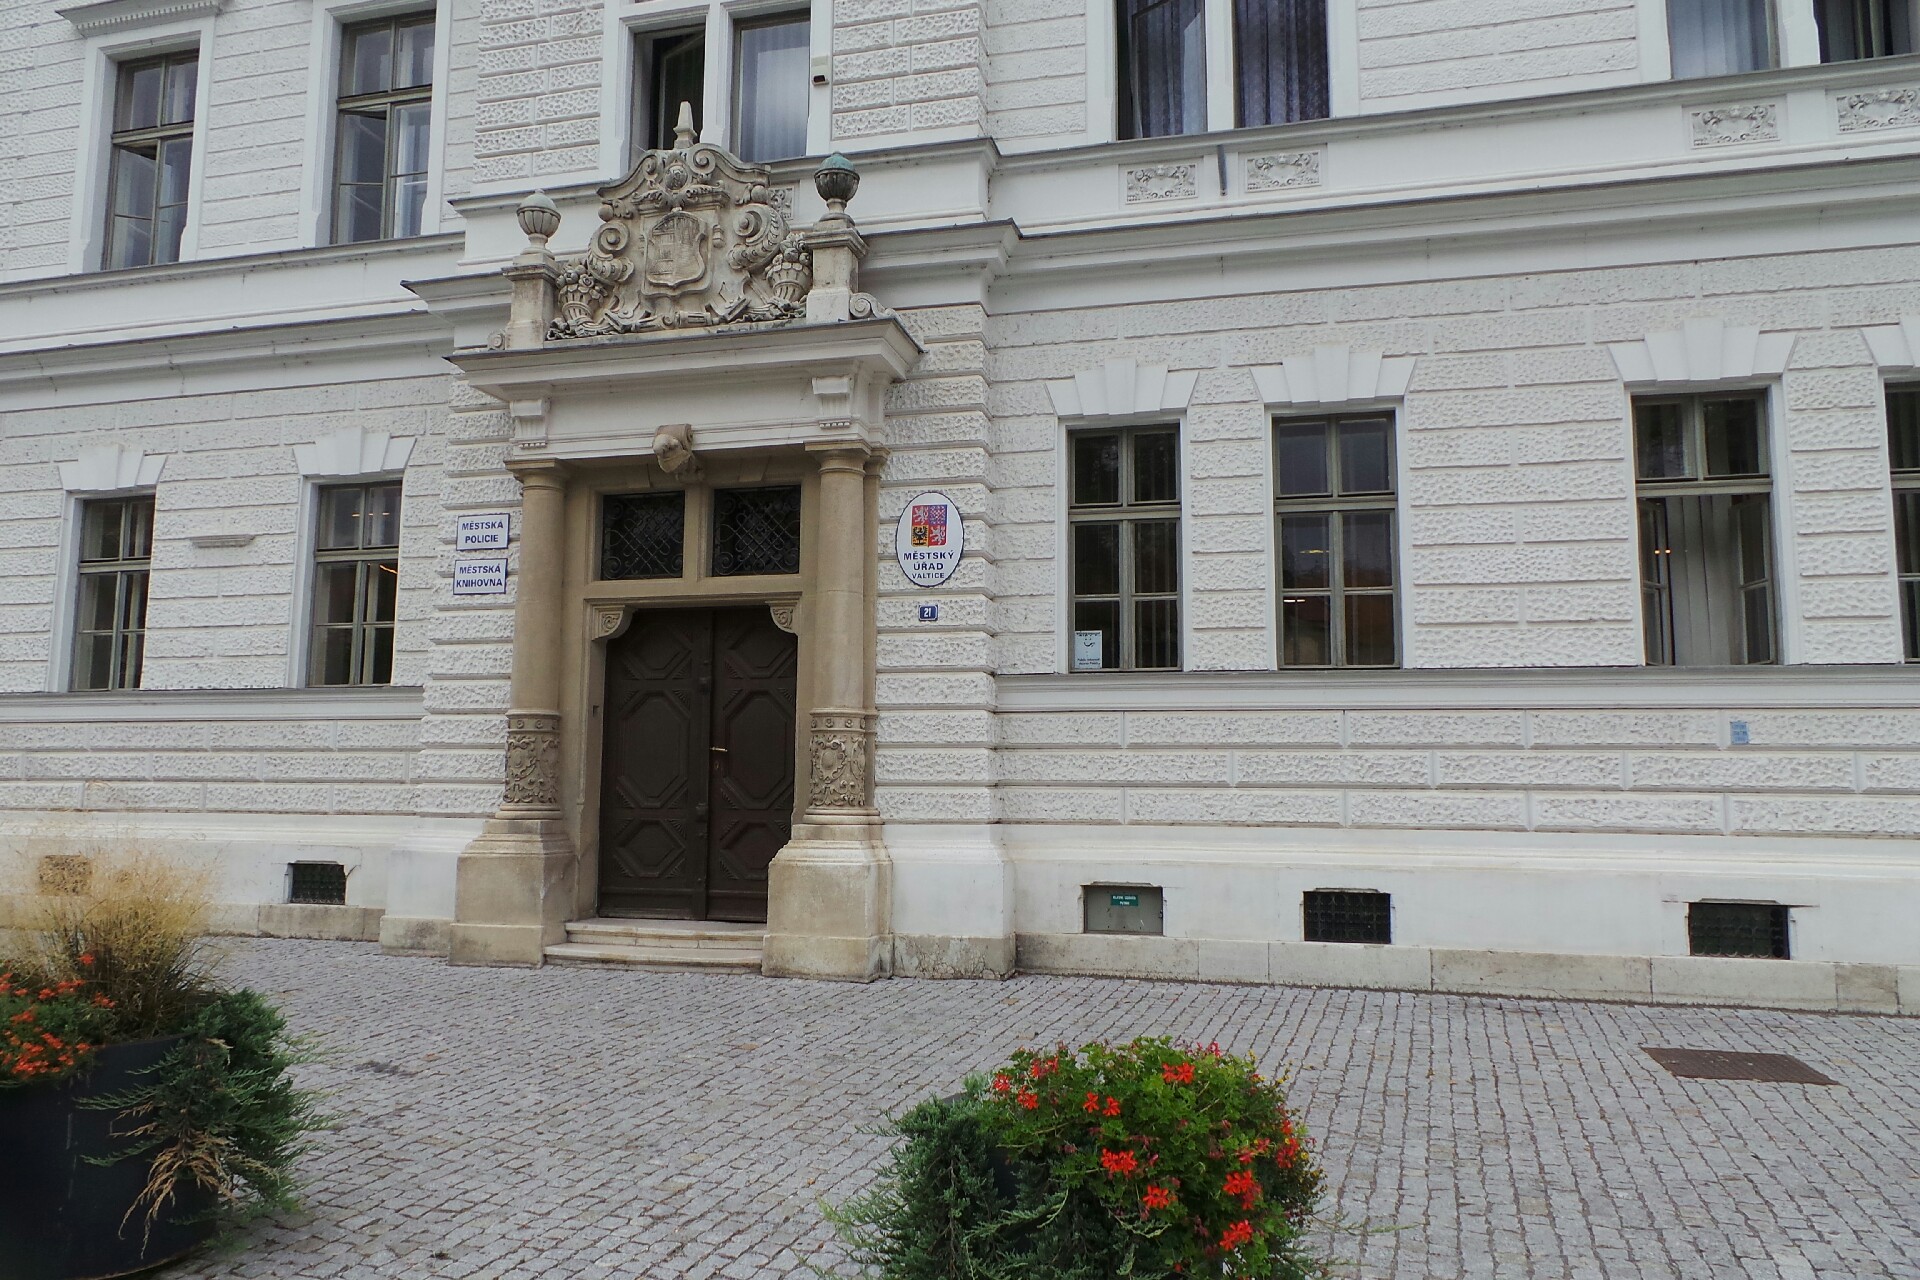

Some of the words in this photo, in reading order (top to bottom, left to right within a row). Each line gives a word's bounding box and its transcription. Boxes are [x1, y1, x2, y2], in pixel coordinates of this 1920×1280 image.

[461, 520, 504, 530] MĚSTSKÁ
[465, 534, 499, 543] POLICIE
[903, 550, 954, 560] MĚSTSKÝ
[459, 563, 502, 574] MĚSTSKÁ
[913, 561, 944, 570] ÚŘAD
[456, 578, 503, 588] KNIHOVNA
[923, 607, 932, 618] 21
